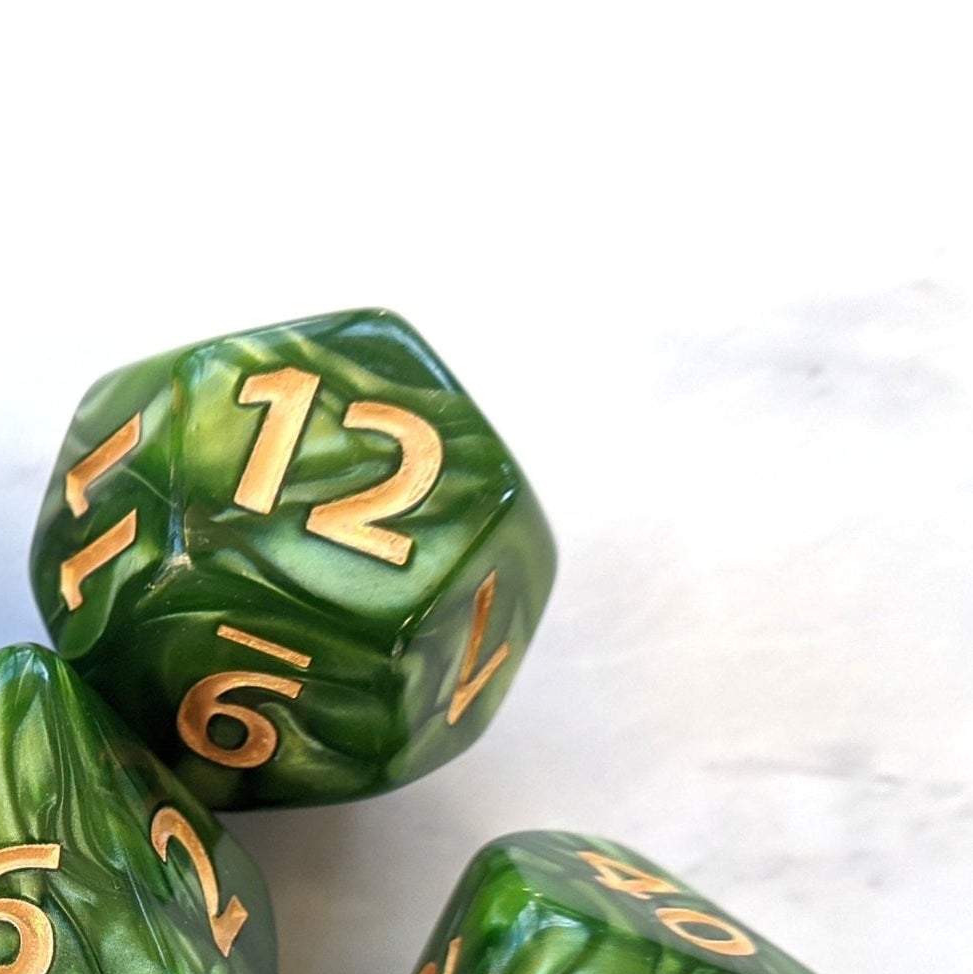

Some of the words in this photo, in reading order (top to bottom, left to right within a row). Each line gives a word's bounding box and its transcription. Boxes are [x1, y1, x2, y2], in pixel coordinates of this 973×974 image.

[233, 367, 443, 566] 12
[151, 806, 249, 958] 2
[578, 851, 756, 956] 40
